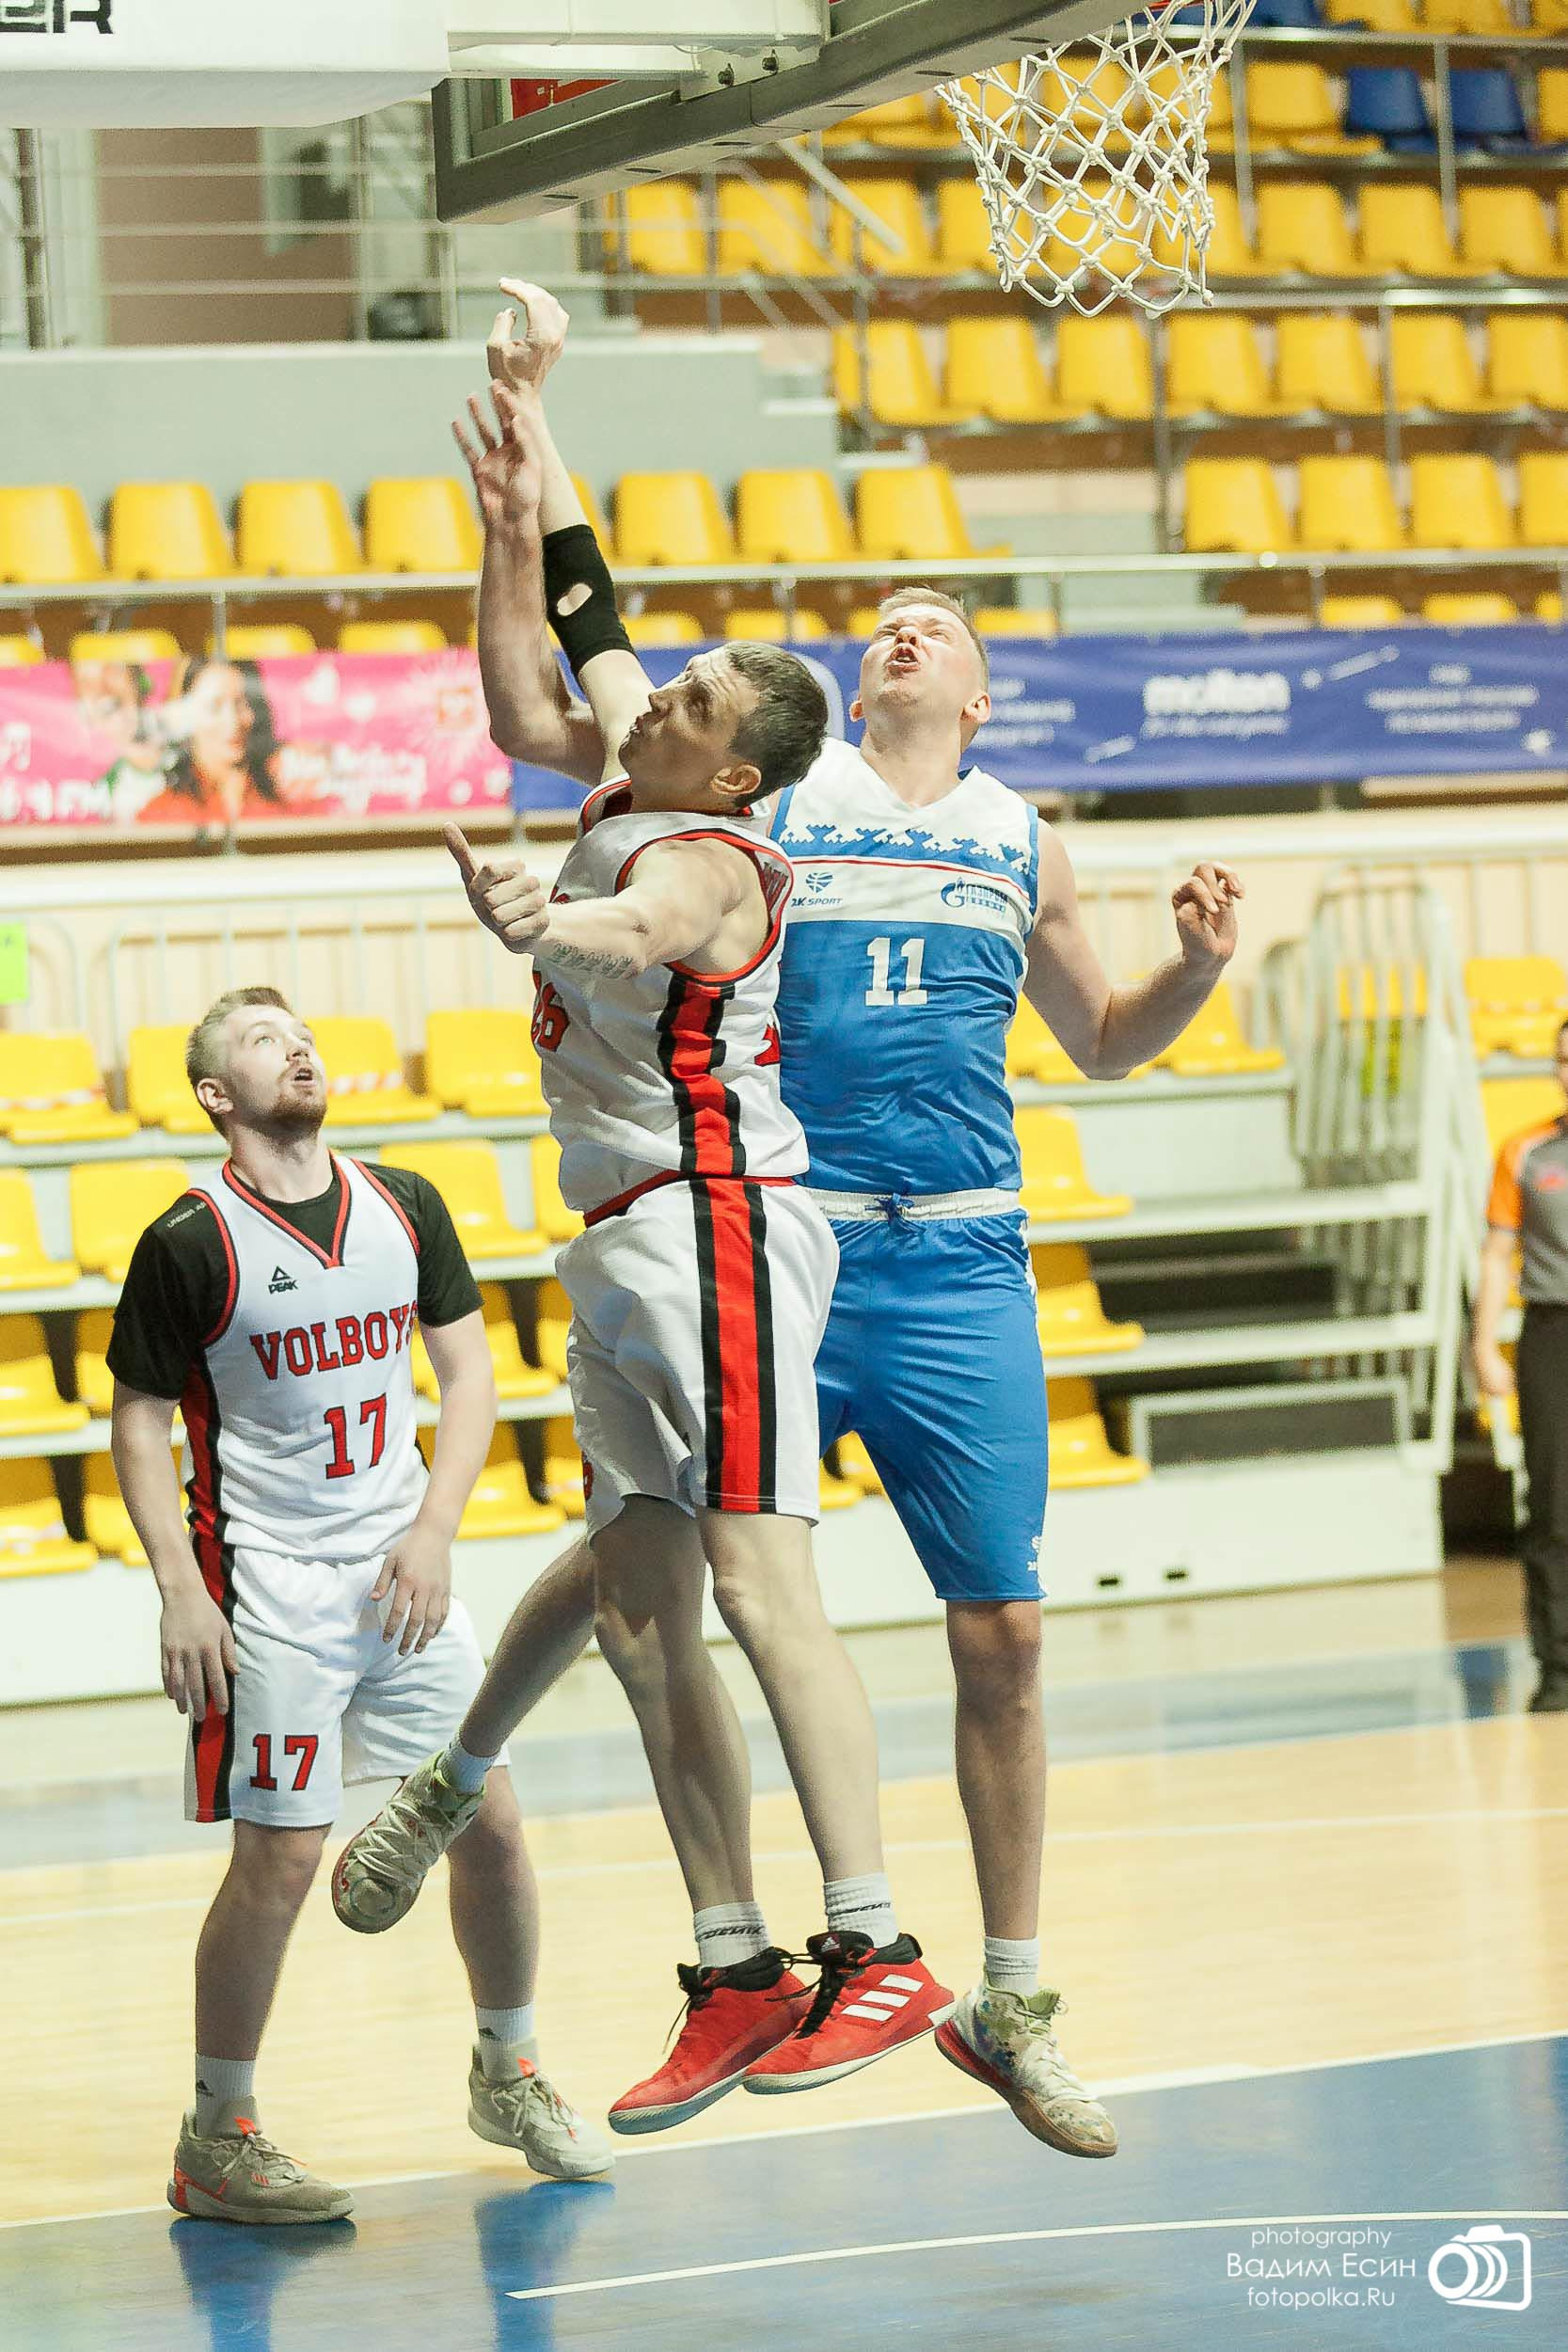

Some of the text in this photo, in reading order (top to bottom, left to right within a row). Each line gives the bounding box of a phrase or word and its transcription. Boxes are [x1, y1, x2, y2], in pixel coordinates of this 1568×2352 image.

[807, 898, 843, 906] SPORT
[865, 936, 928, 1007] 11
[268, 1279, 299, 1295] PEAK
[324, 1392, 388, 1480] 17
[249, 1733, 319, 1791] 17
